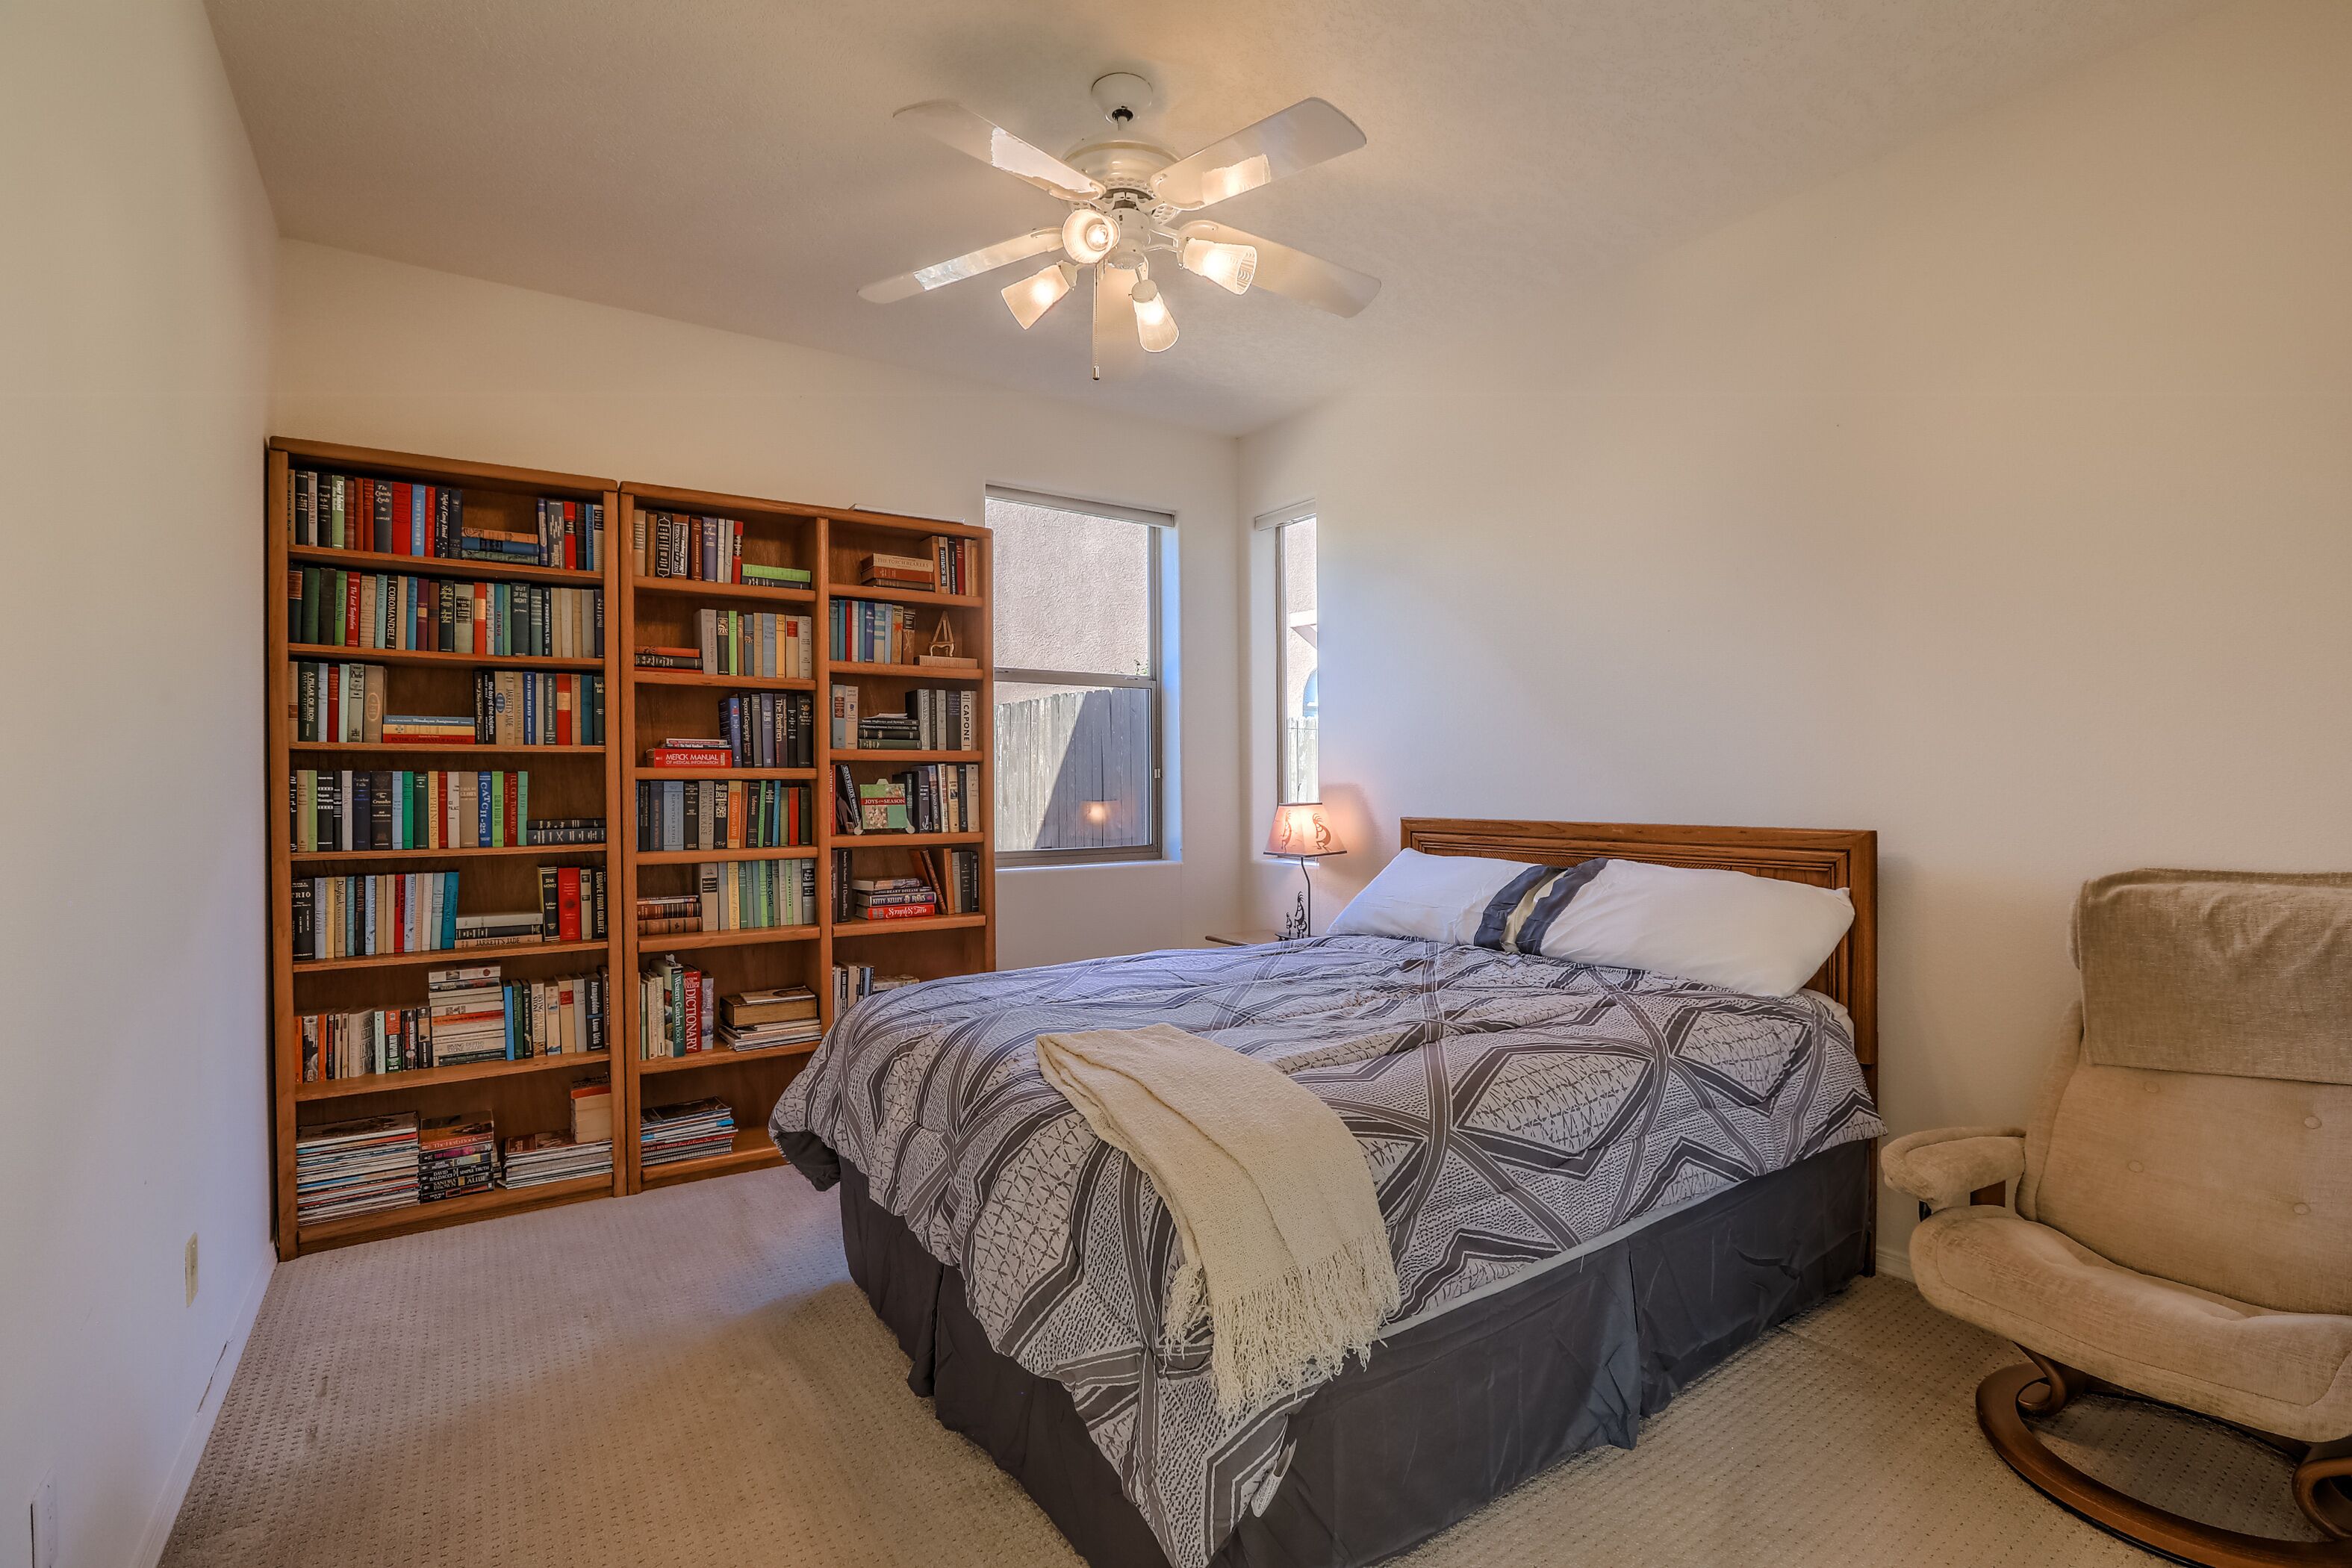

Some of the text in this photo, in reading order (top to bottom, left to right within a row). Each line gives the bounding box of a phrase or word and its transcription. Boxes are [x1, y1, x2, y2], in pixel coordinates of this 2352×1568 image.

[889, 559, 929, 567] TORCHBEARERS
[348, 606, 357, 630] Temptation
[387, 586, 396, 640] COROMANDEL!
[922, 691, 928, 702] WE
[843, 766, 856, 798] SIDNEY SHELDON
[479, 782, 491, 834] CATCH-22
[335, 880, 344, 906] Daybreak
[475, 938, 505, 947] JARRETT'S
[591, 981, 600, 1014] Armageddon
[674, 1002, 682, 1026] Garden
[685, 989, 697, 1051] DICTIONARY
[389, 1035, 397, 1058] REDEMPTION
[592, 1033, 600, 1044] Uris
[675, 1026, 683, 1044] Book
[461, 1136, 478, 1145] Book
[429, 1174, 453, 1182] BALDACCI
